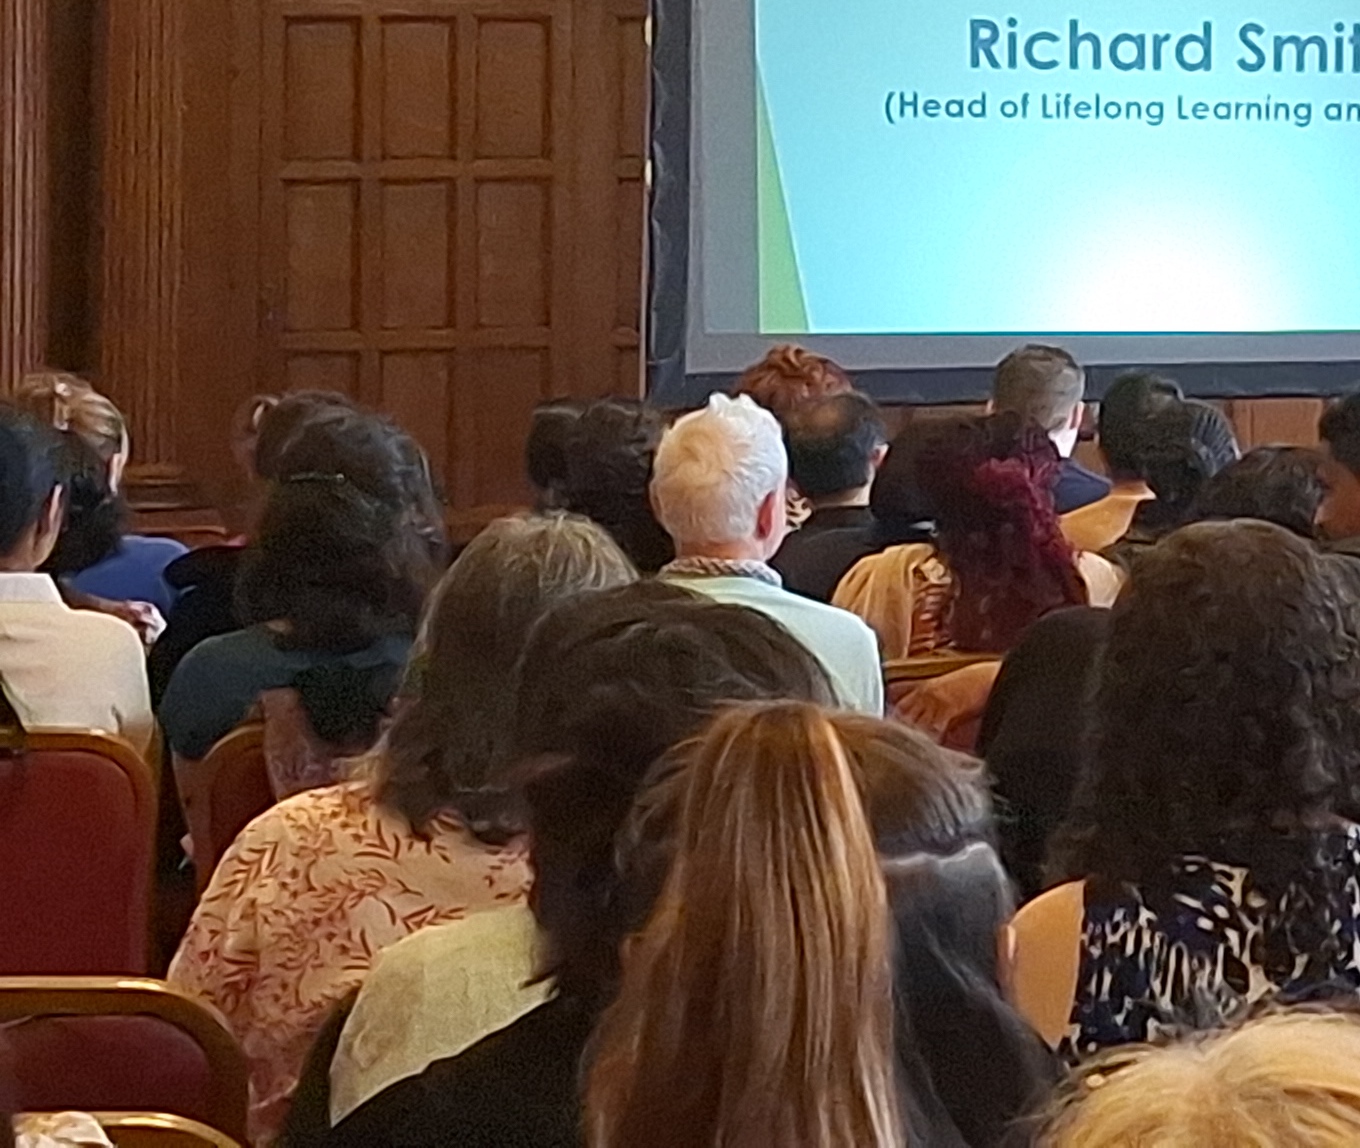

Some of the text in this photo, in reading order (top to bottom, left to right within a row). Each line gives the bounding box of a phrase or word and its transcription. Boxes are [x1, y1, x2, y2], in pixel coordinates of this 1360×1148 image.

[969, 17, 1212, 72] Richard
[885, 91, 987, 124] (Head
[1000, 92, 1029, 119] of
[1041, 92, 1164, 126] Lifelong
[1177, 94, 1312, 128] Learning
